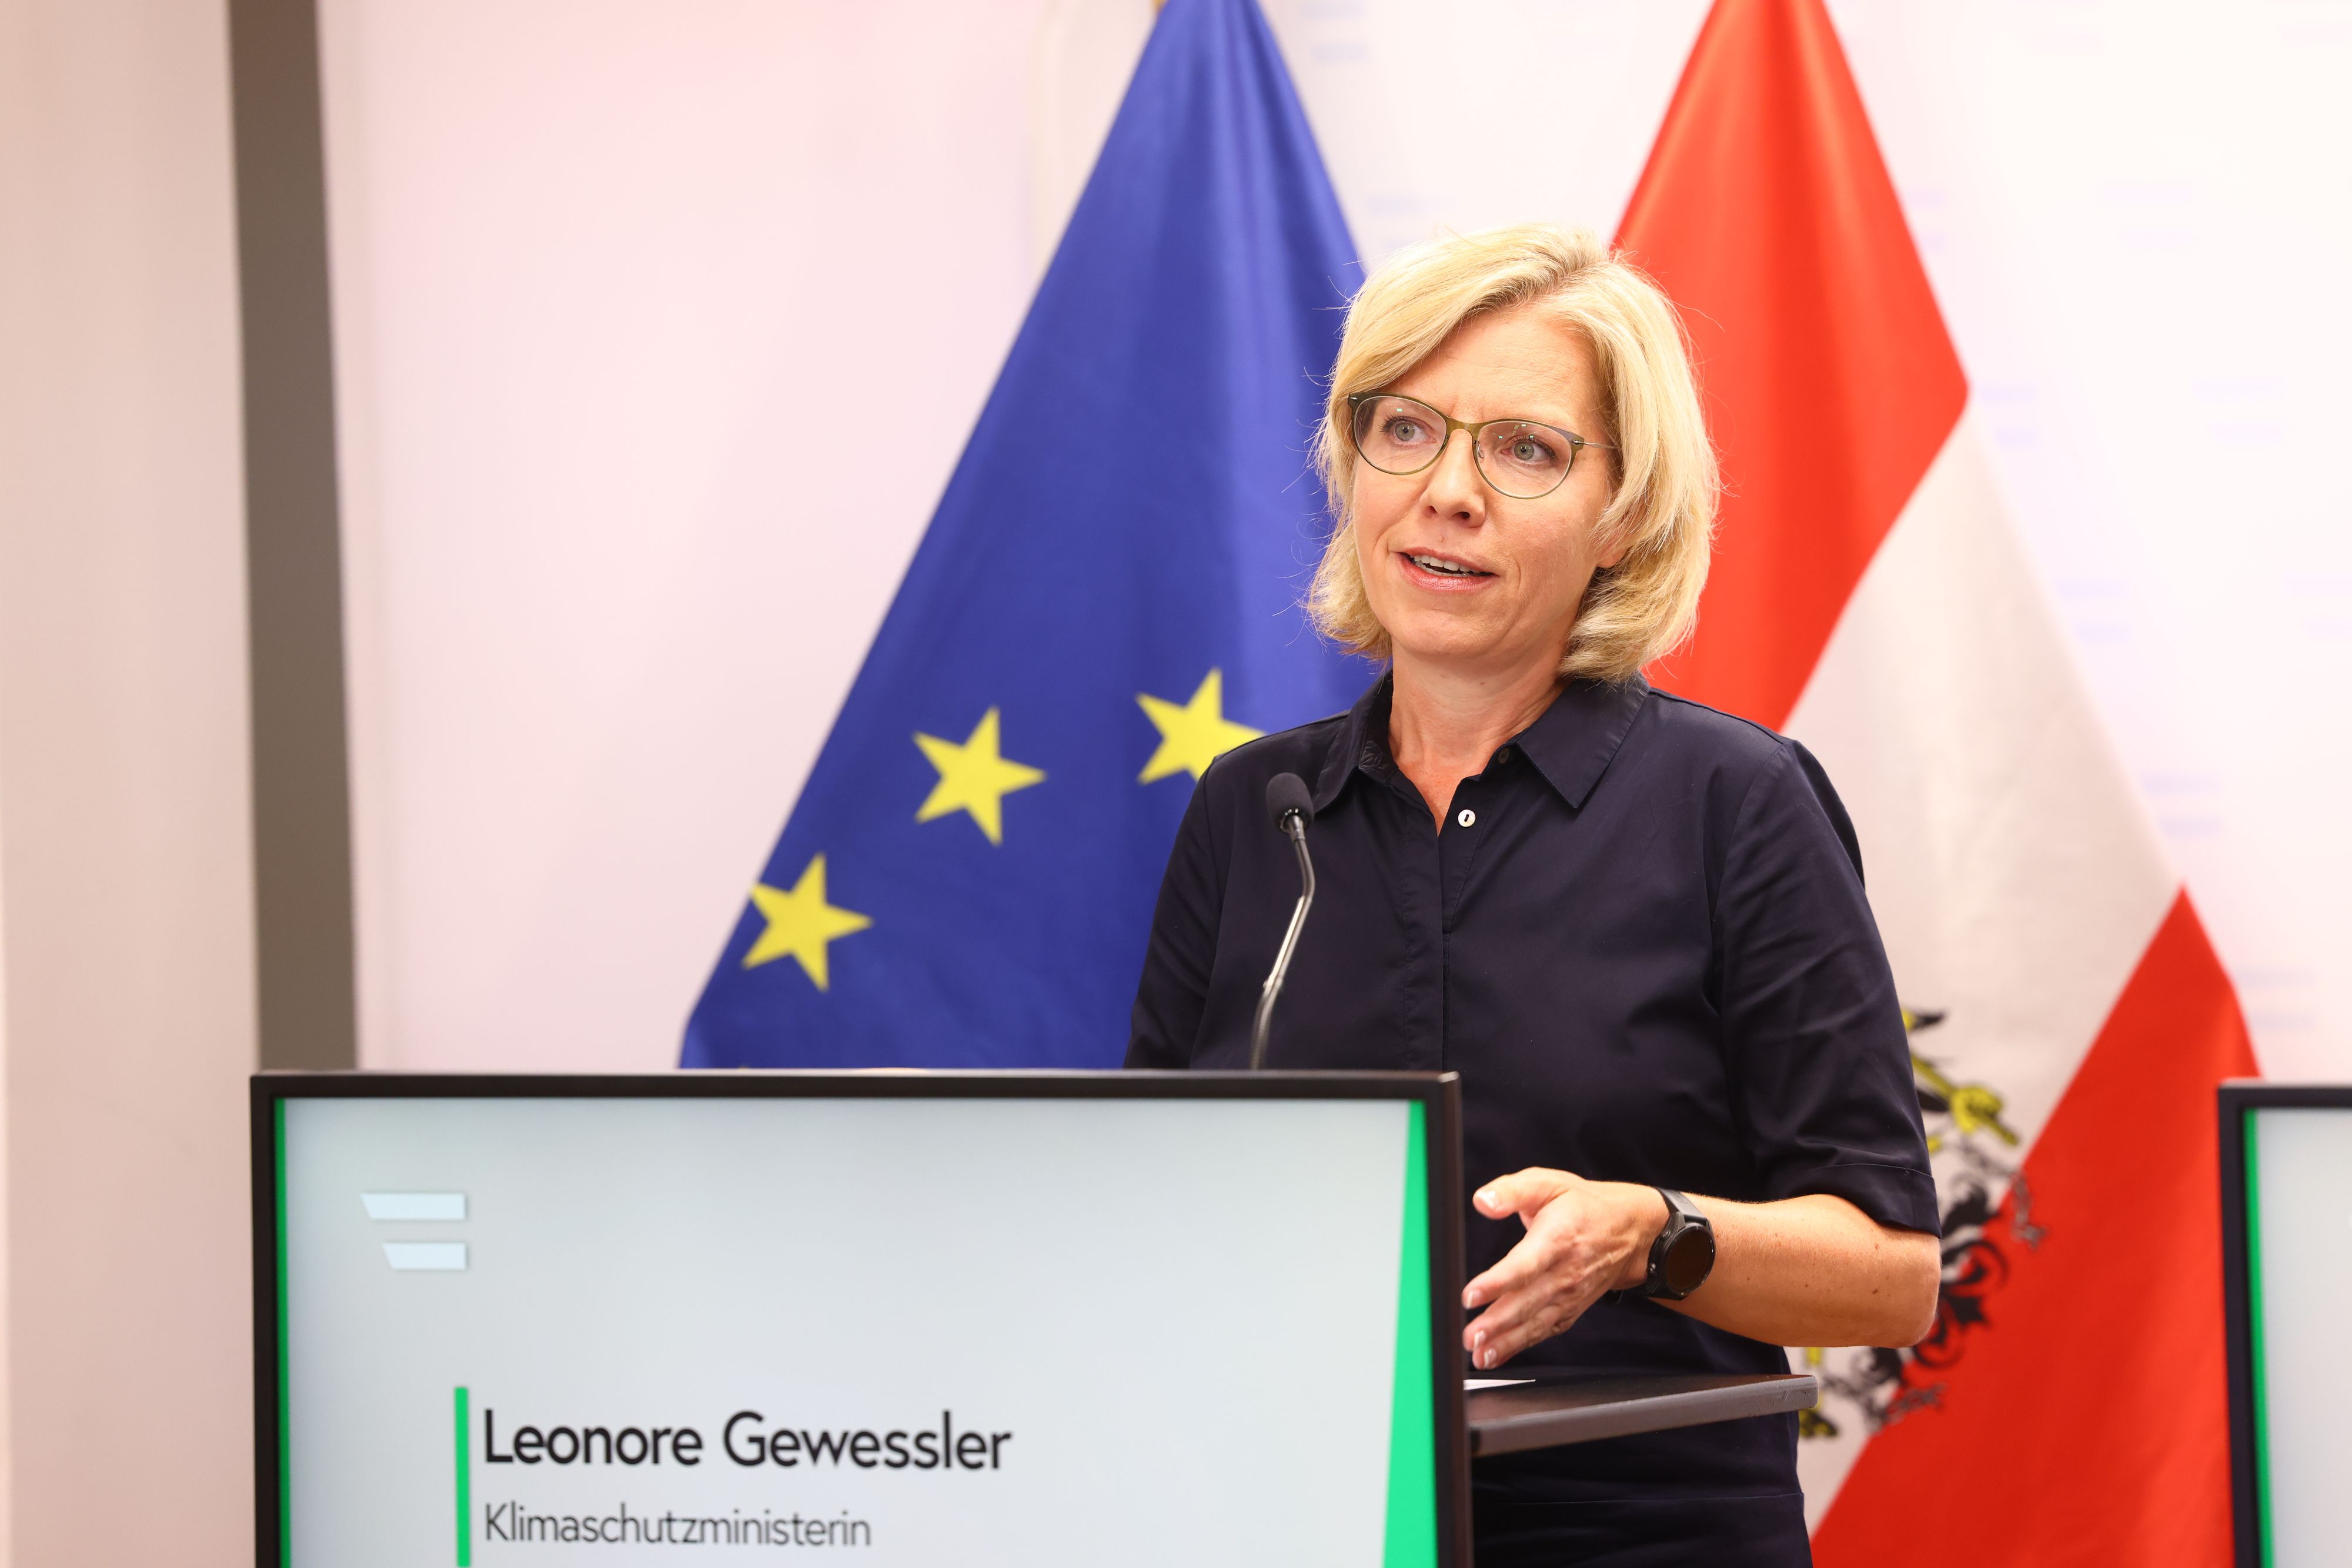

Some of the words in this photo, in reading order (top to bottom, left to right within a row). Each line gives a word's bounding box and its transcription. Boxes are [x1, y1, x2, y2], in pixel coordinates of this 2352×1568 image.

[483, 1407, 704, 1468] Leonore
[722, 1410, 1013, 1471] Gewessler
[485, 1500, 871, 1547] Klimaschutzministerin
